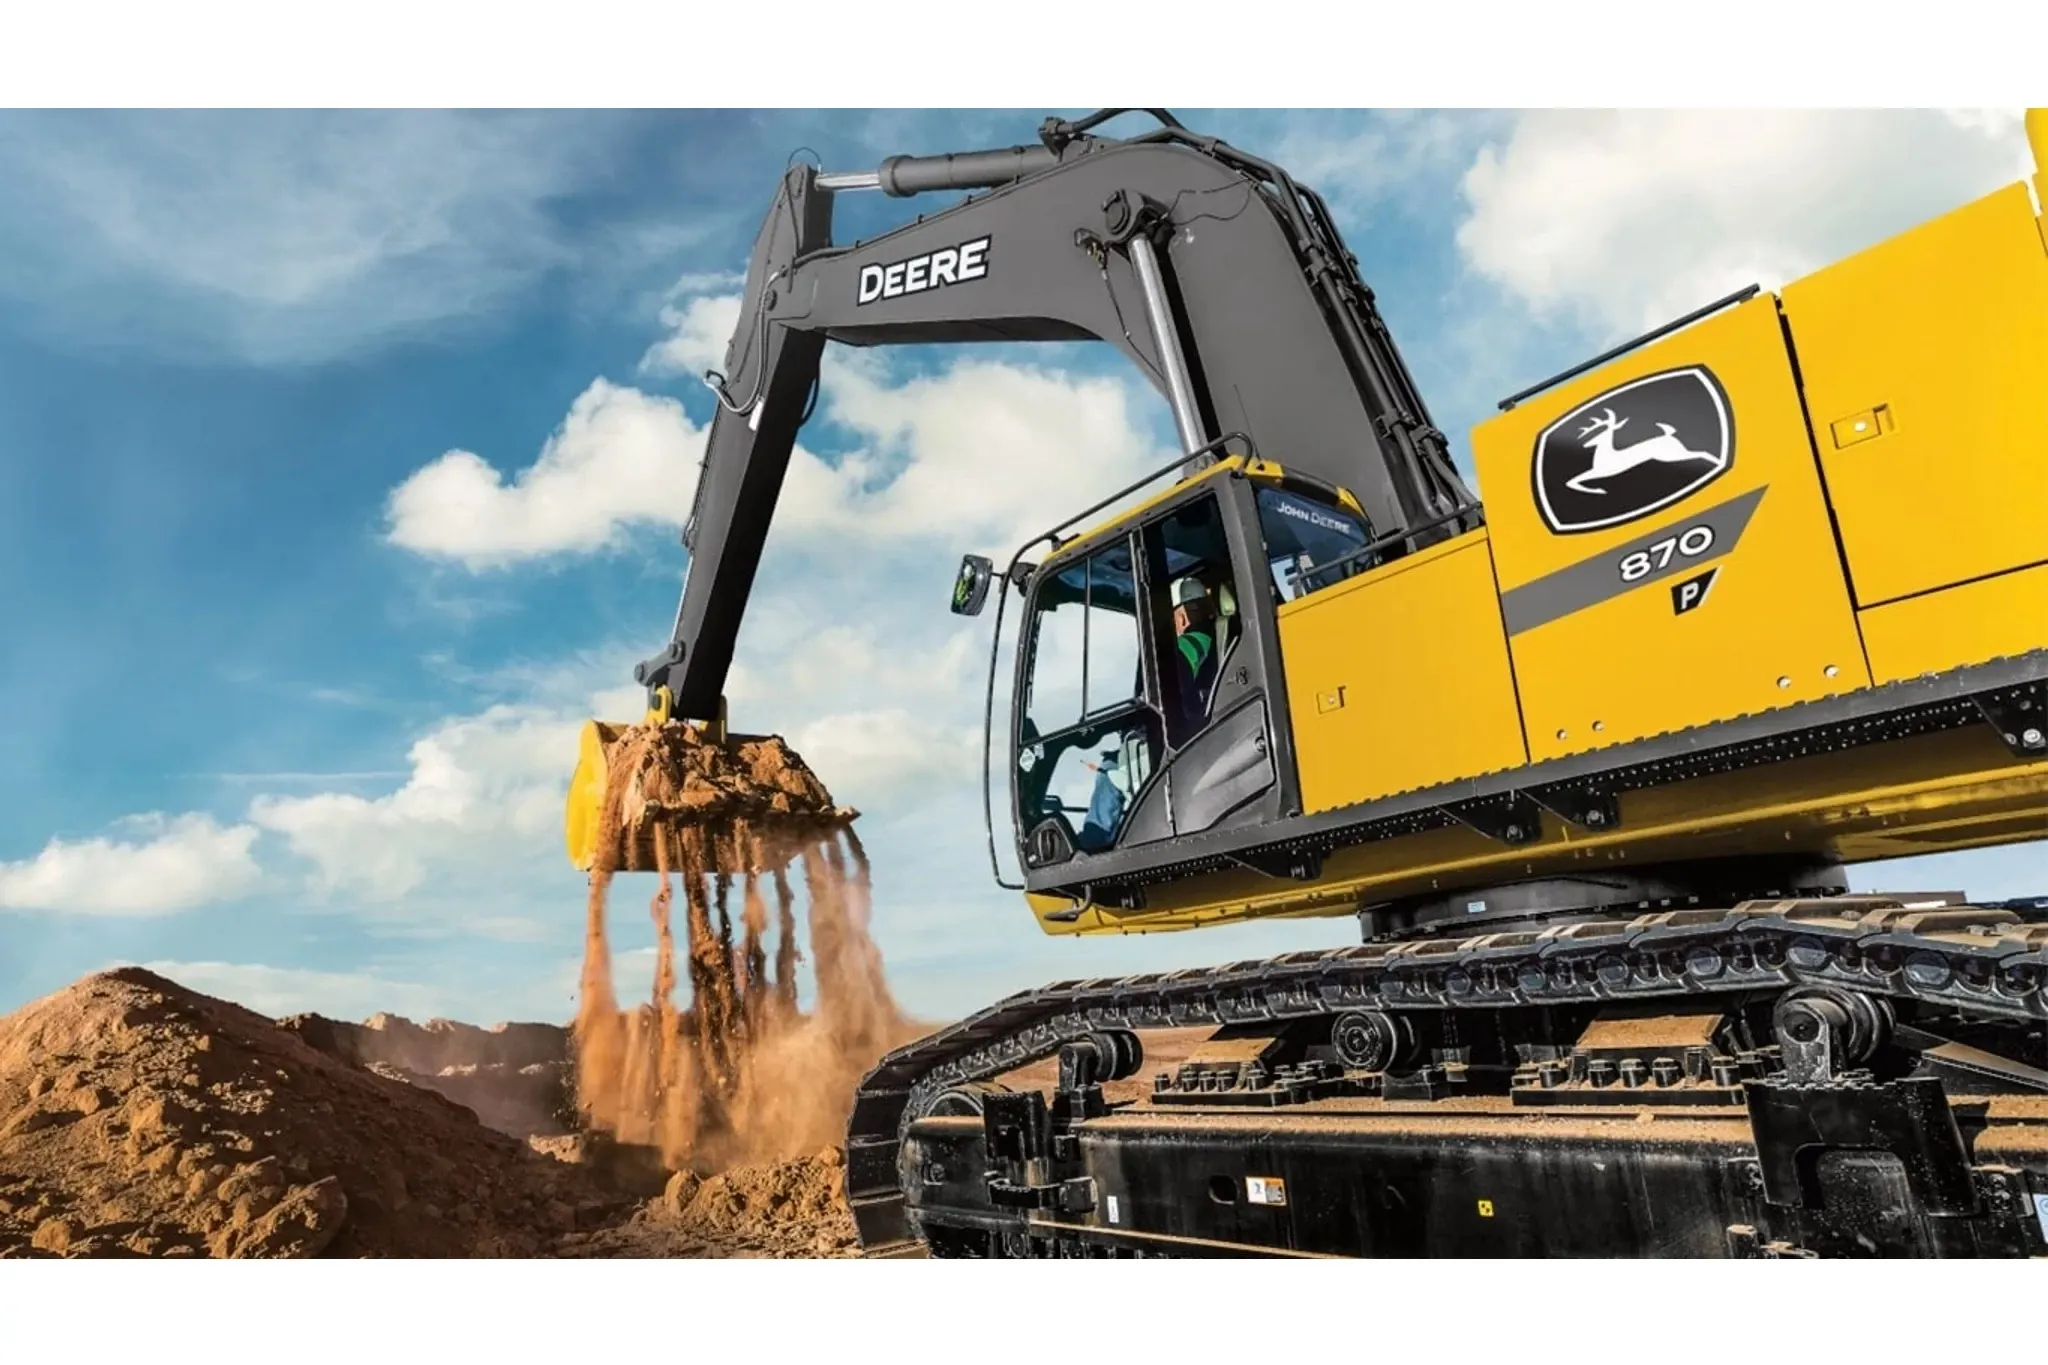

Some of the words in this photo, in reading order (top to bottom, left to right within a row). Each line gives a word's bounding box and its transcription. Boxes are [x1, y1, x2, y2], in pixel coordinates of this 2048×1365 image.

[858, 237, 990, 305] DEERE
[1277, 501, 1309, 521] JOHN
[1311, 512, 1350, 535] DEERE
[1620, 526, 1713, 581] 870
[1681, 582, 1699, 610] P
